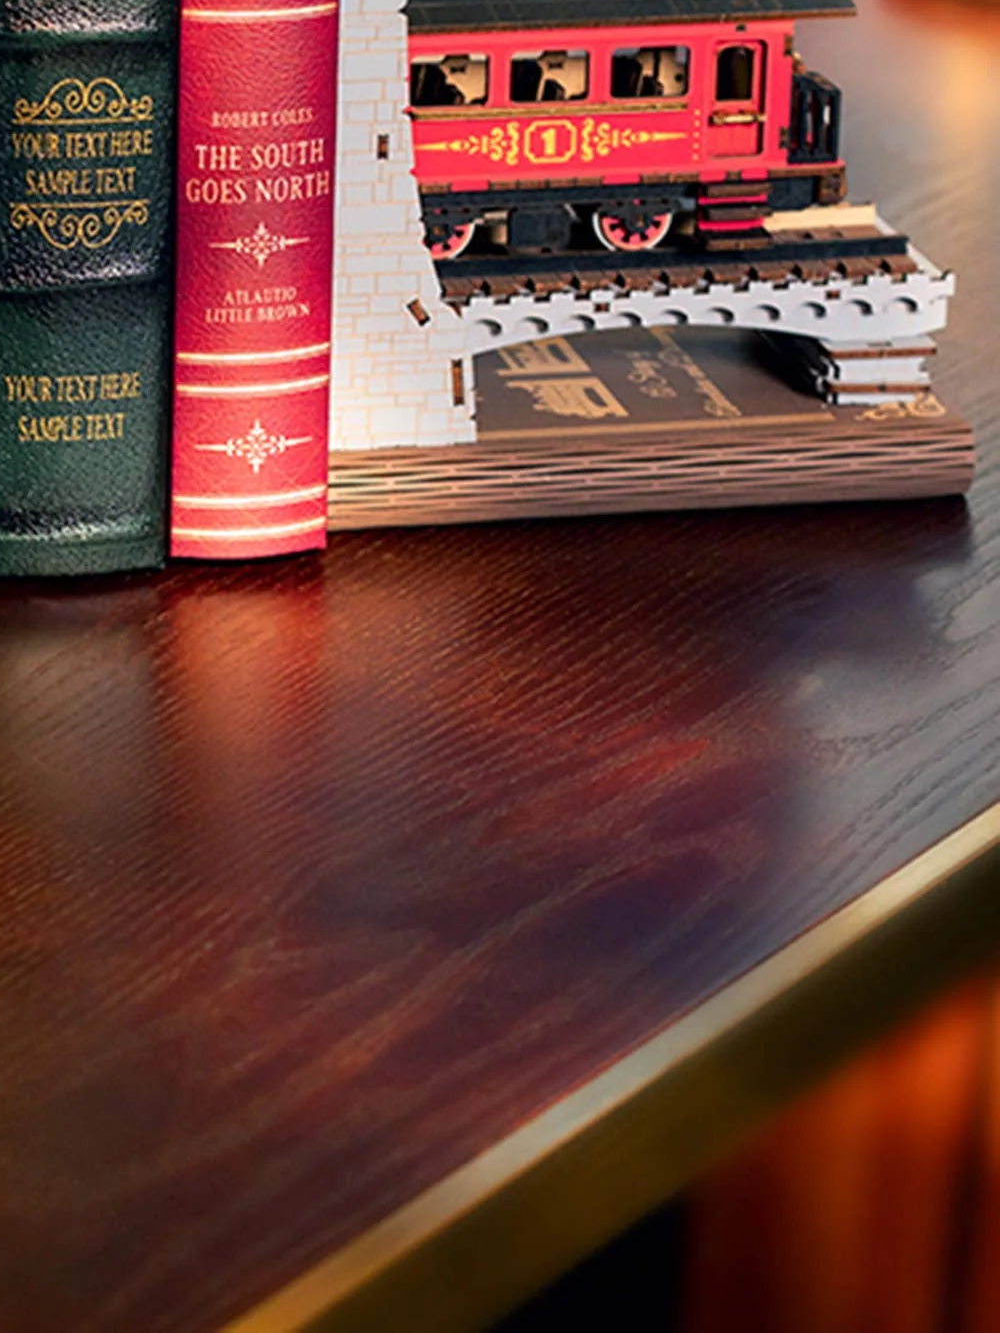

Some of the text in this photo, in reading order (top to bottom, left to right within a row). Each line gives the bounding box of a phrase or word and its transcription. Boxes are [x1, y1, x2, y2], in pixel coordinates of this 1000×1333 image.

[12, 129, 153, 158] YOUR TEXT HERE
[195, 137, 325, 170] THE SOUTH
[541, 127, 556, 156] 1
[25, 166, 136, 196] SAMPLE TEXT
[186, 170, 330, 204] GOES NORTH
[205, 307, 254, 323] LITTLE
[4, 370, 142, 404] YOUR TEXT HERE
[18, 412, 126, 442] SAMPLE TEXT
